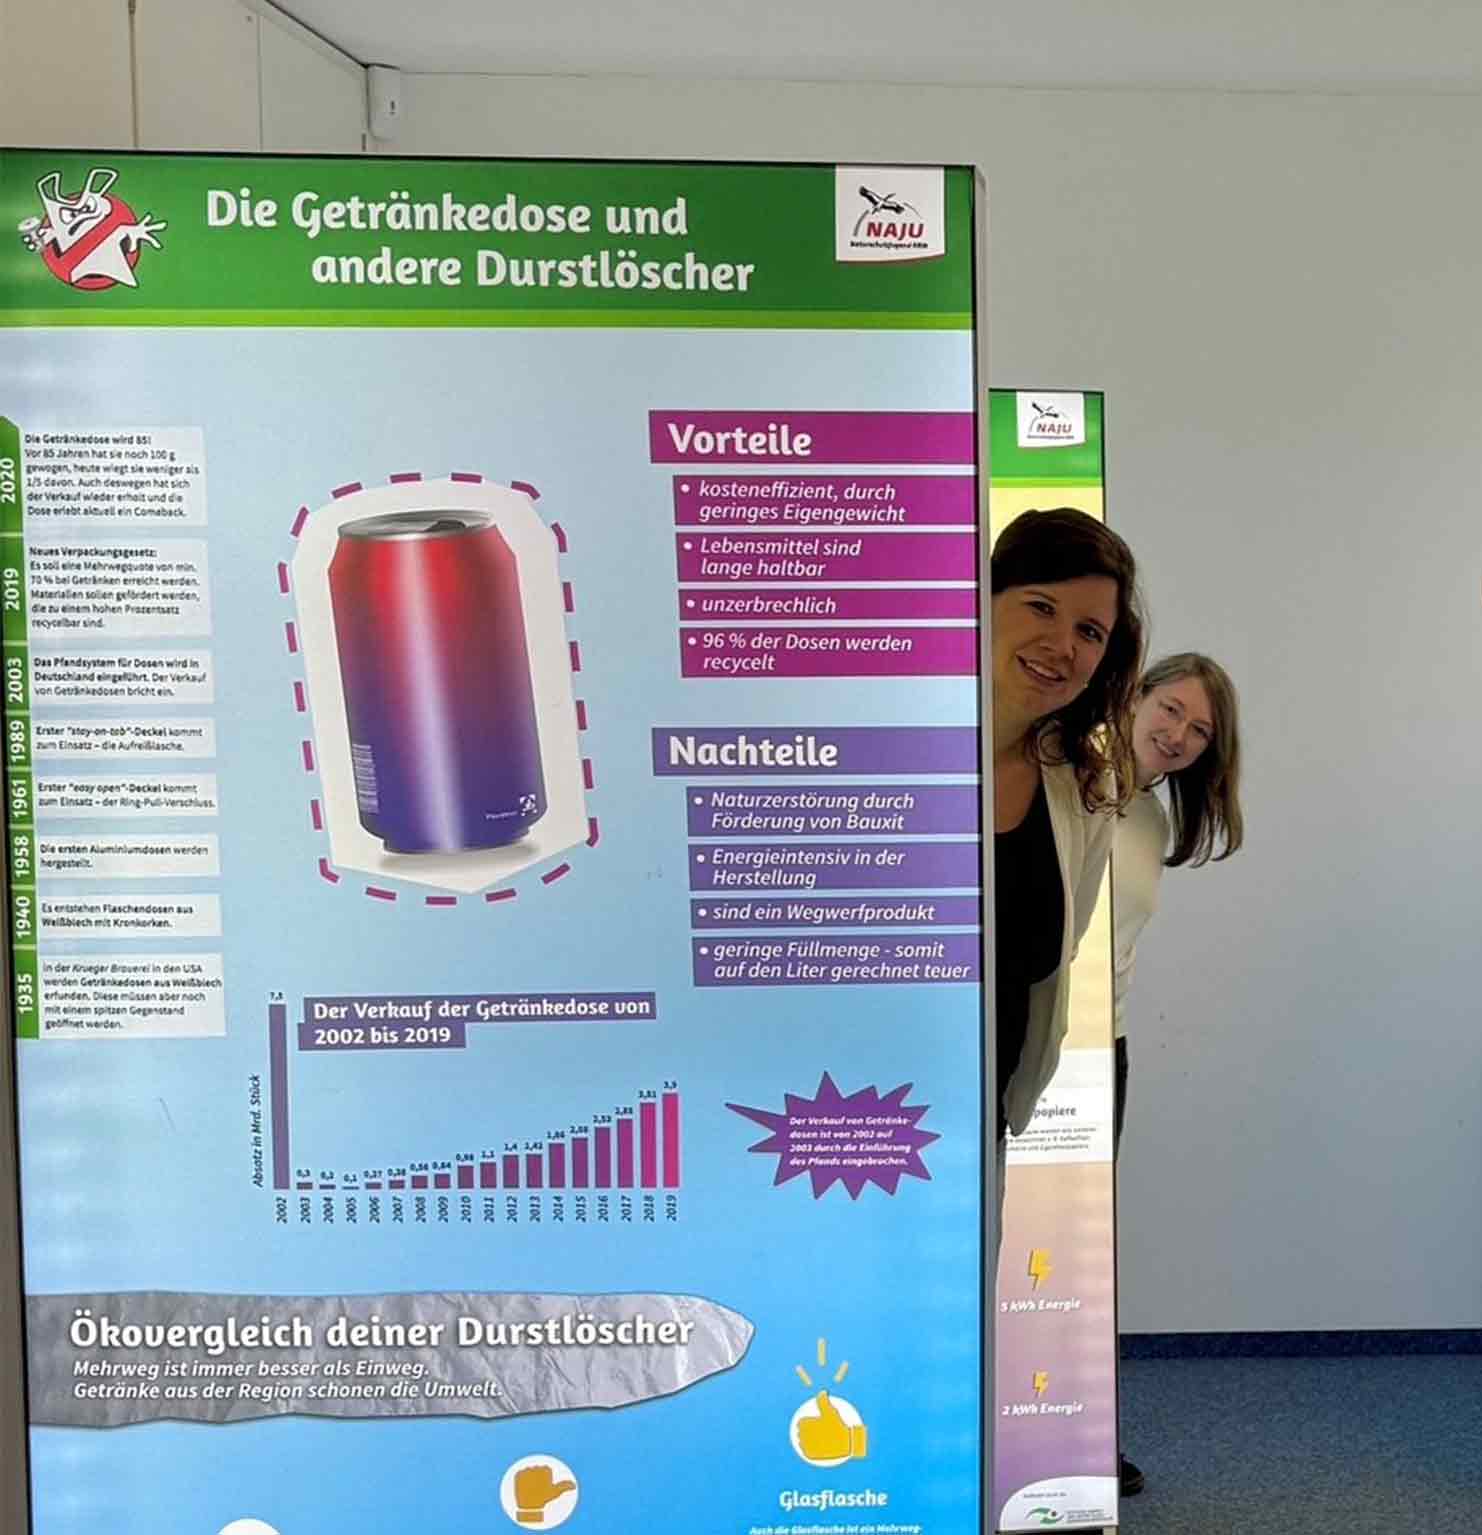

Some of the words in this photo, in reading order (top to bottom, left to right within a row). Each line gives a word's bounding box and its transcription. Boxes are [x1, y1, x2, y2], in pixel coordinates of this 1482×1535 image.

[208, 188, 277, 227] Die
[292, 191, 590, 238] Getränkedose
[607, 197, 687, 234] und
[867, 221, 924, 240] NAJU
[312, 249, 461, 285] andere
[477, 250, 754, 291] Durstlöscher
[668, 424, 811, 455] Vorteile
[1036, 423, 1073, 434] NAJU
[1, 458, 15, 503] 2020
[699, 480, 837, 505] kosteneffizient,
[844, 483, 895, 500] durch
[699, 502, 778, 523] geringes
[784, 503, 906, 524] Eigengewicht
[701, 537, 819, 555] Lebensmittel
[823, 539, 861, 556] sind
[701, 558, 752, 579] lange
[757, 559, 826, 576] haltbar
[5, 568, 20, 610] 2019
[702, 596, 836, 613] unzerbrechlich
[704, 633, 724, 648] 96
[729, 633, 746, 648] %
[751, 633, 781, 649] der
[786, 634, 840, 650] Dosen
[846, 635, 912, 650] werden
[704, 654, 775, 673] recycelt
[8, 657, 23, 703] 2003
[10, 720, 25, 762] 1989
[670, 736, 837, 766] Nachteile
[13, 779, 27, 817] 1961
[712, 792, 859, 812] Naturzerstörung
[864, 793, 914, 809] durch
[712, 812, 805, 832] Förderung
[810, 817, 841, 829] von
[847, 814, 904, 829] Bauxit
[14, 836, 29, 877] 1958
[713, 848, 851, 868] Energieintensiv
[855, 849, 870, 864] in
[875, 849, 905, 865] der
[713, 870, 817, 888] Herstellung
[15, 896, 30, 937] 1940
[713, 904, 751, 919] sind
[755, 904, 782, 919] ein
[788, 904, 935, 924] Wegwerfprodukt
[714, 945, 782, 961] geringe
[787, 941, 880, 961] Füllmenge
[895, 942, 944, 957] somit
[715, 962, 747, 980] auf
[749, 962, 781, 977] den
[787, 962, 828, 977] Liter
[831, 962, 920, 982] gerechnet
[925, 965, 971, 978] teuer
[17, 973, 32, 1013] 1935
[314, 1003, 348, 1019] Der
[354, 1001, 432, 1021] Verkauf
[438, 1000, 470, 1016] der
[476, 998, 608, 1020] Getränkedose
[615, 1002, 649, 1014] von
[315, 1029, 364, 1044] 2002
[371, 1026, 398, 1043] bis
[404, 1027, 450, 1042] 2019
[70, 1309, 312, 1355] Ökovergleich
[327, 1316, 443, 1347] deiner
[458, 1314, 694, 1346] Durstlöscher
[73, 1360, 158, 1380] Mehrweg
[164, 1360, 187, 1376] ist
[191, 1360, 252, 1376] immer
[258, 1359, 319, 1376] besser
[324, 1358, 351, 1376] als
[356, 1358, 429, 1378] Einweg.
[74, 1381, 160, 1399] Getränke
[165, 1385, 197, 1399] aus
[202, 1383, 233, 1398] der
[239, 1382, 300, 1402] Region
[307, 1382, 384, 1398] schonen
[390, 1382, 418, 1397] die
[424, 1380, 502, 1398] Umwelt.
[779, 1489, 887, 1511] Glasflasche
